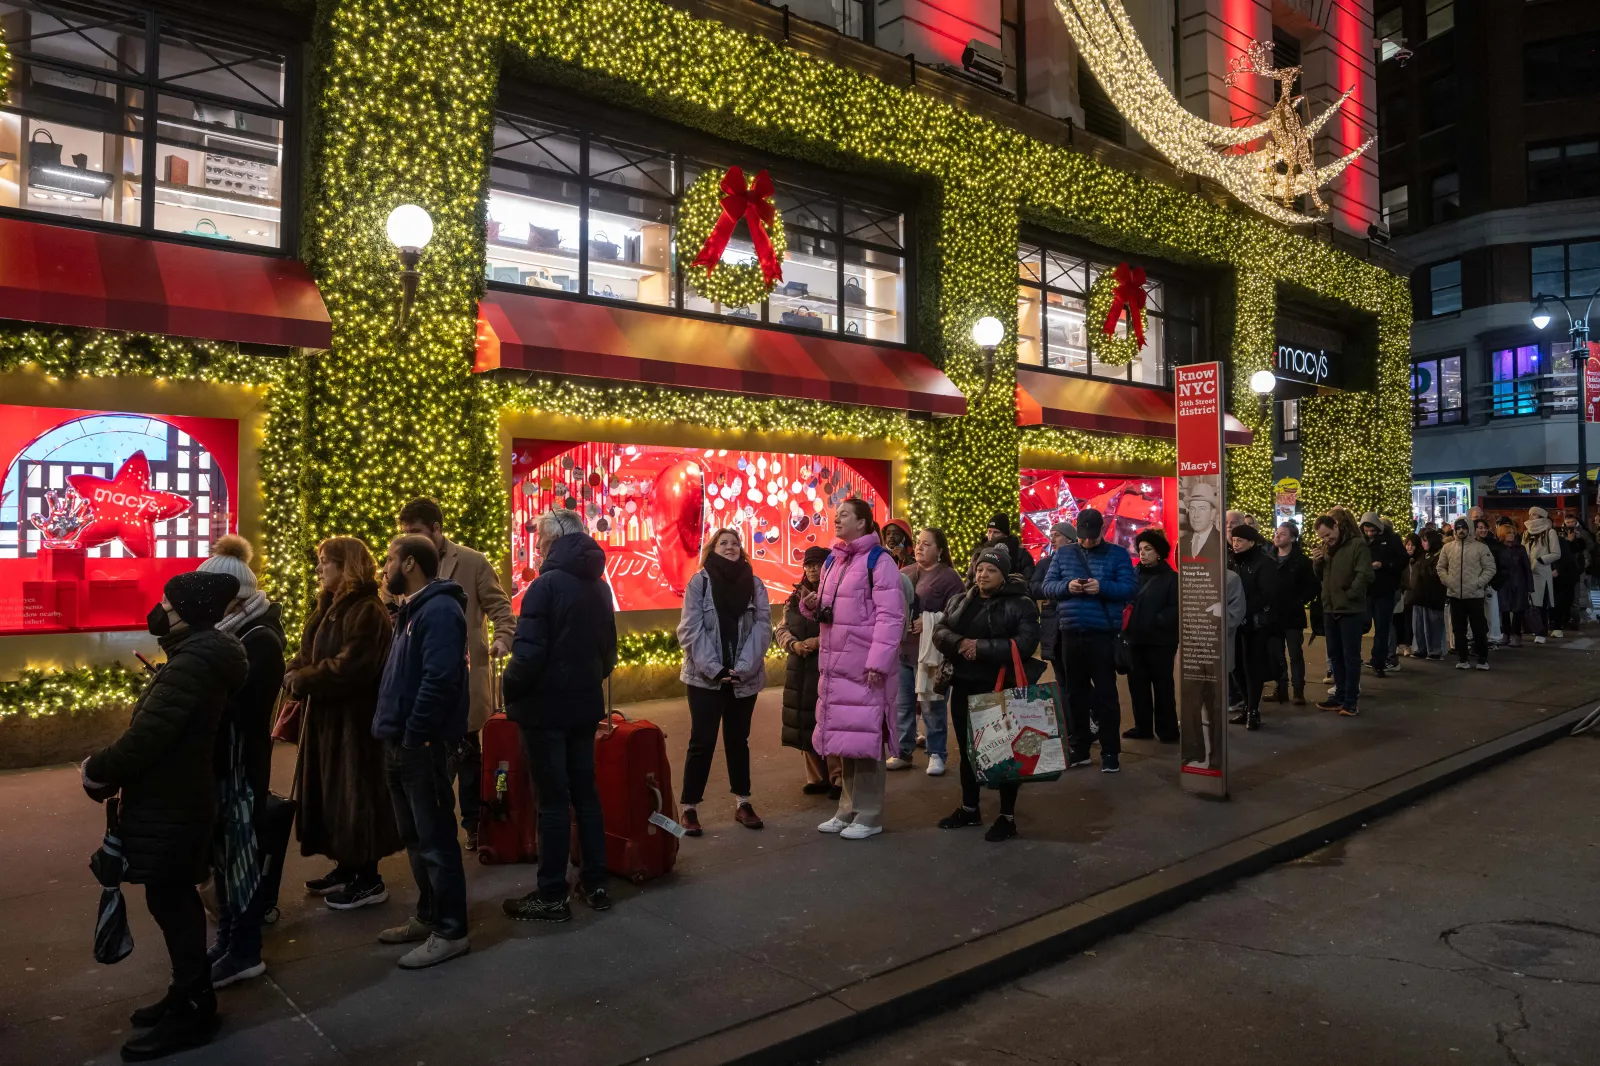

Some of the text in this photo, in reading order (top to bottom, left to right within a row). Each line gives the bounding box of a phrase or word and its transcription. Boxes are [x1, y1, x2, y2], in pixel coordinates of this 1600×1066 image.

[1179, 369, 1214, 382] know
[1179, 381, 1215, 397] NYC
[1195, 398, 1215, 406] Street
[1180, 406, 1215, 417] district
[1181, 460, 1217, 472] Macy's
